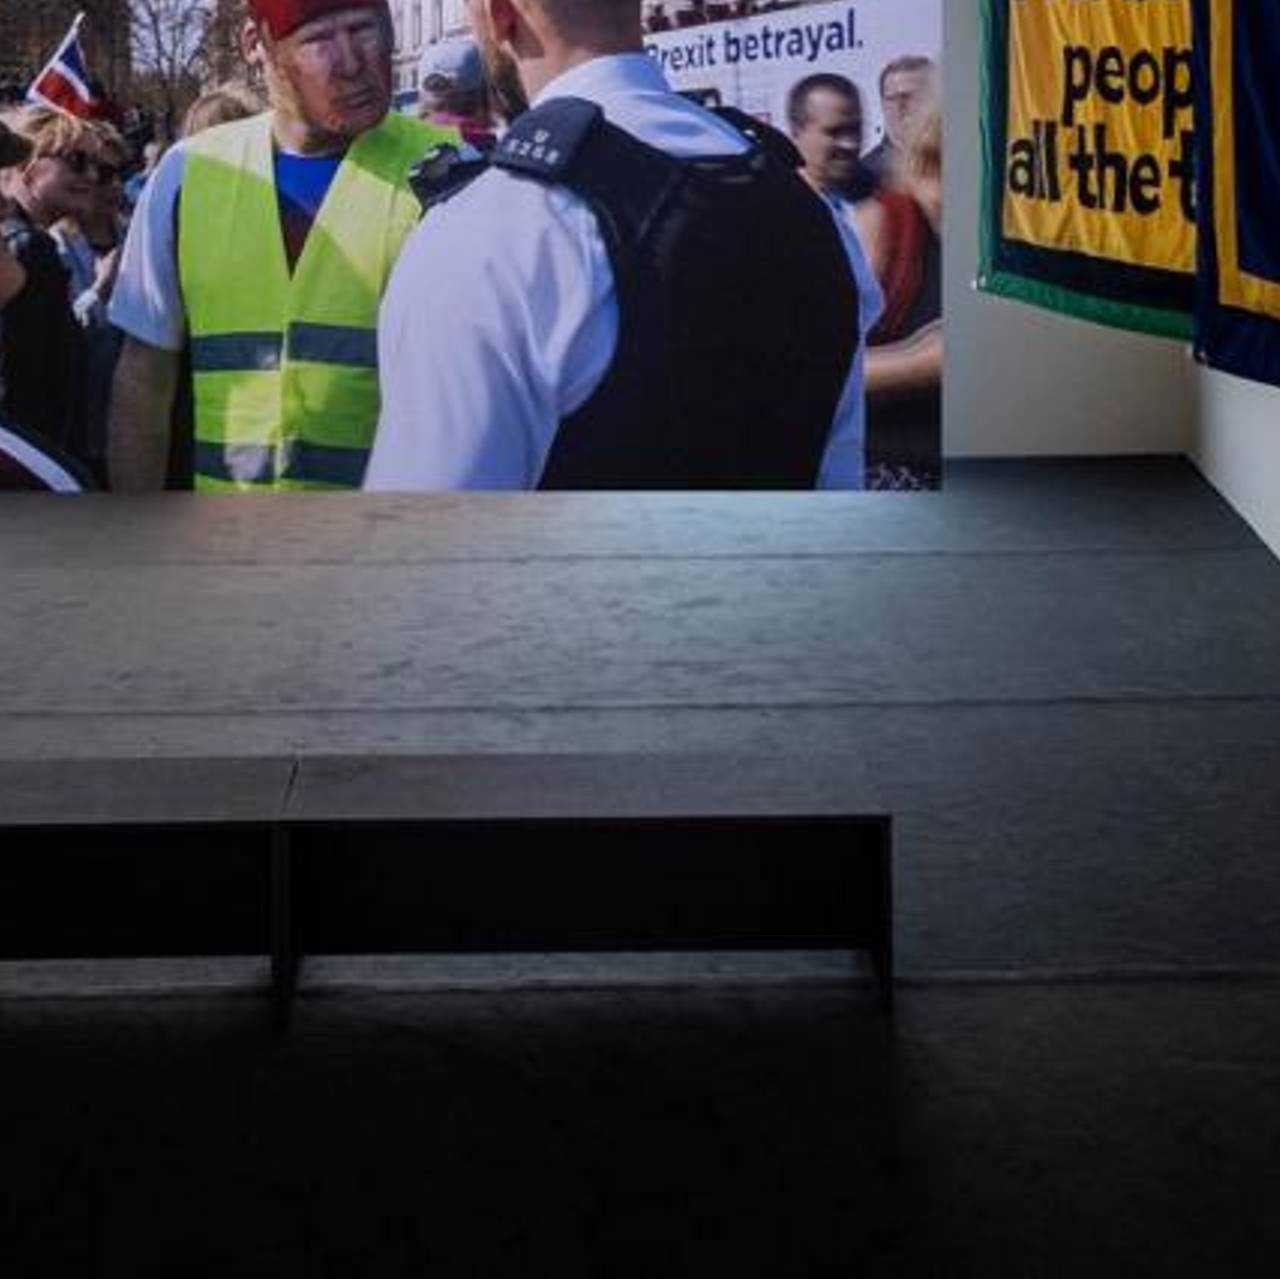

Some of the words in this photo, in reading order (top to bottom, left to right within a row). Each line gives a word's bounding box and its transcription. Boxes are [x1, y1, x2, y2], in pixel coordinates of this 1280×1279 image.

[723, 8, 864, 67] betrayal.
[1007, 121, 1061, 204] all
[1069, 123, 1162, 216] the
